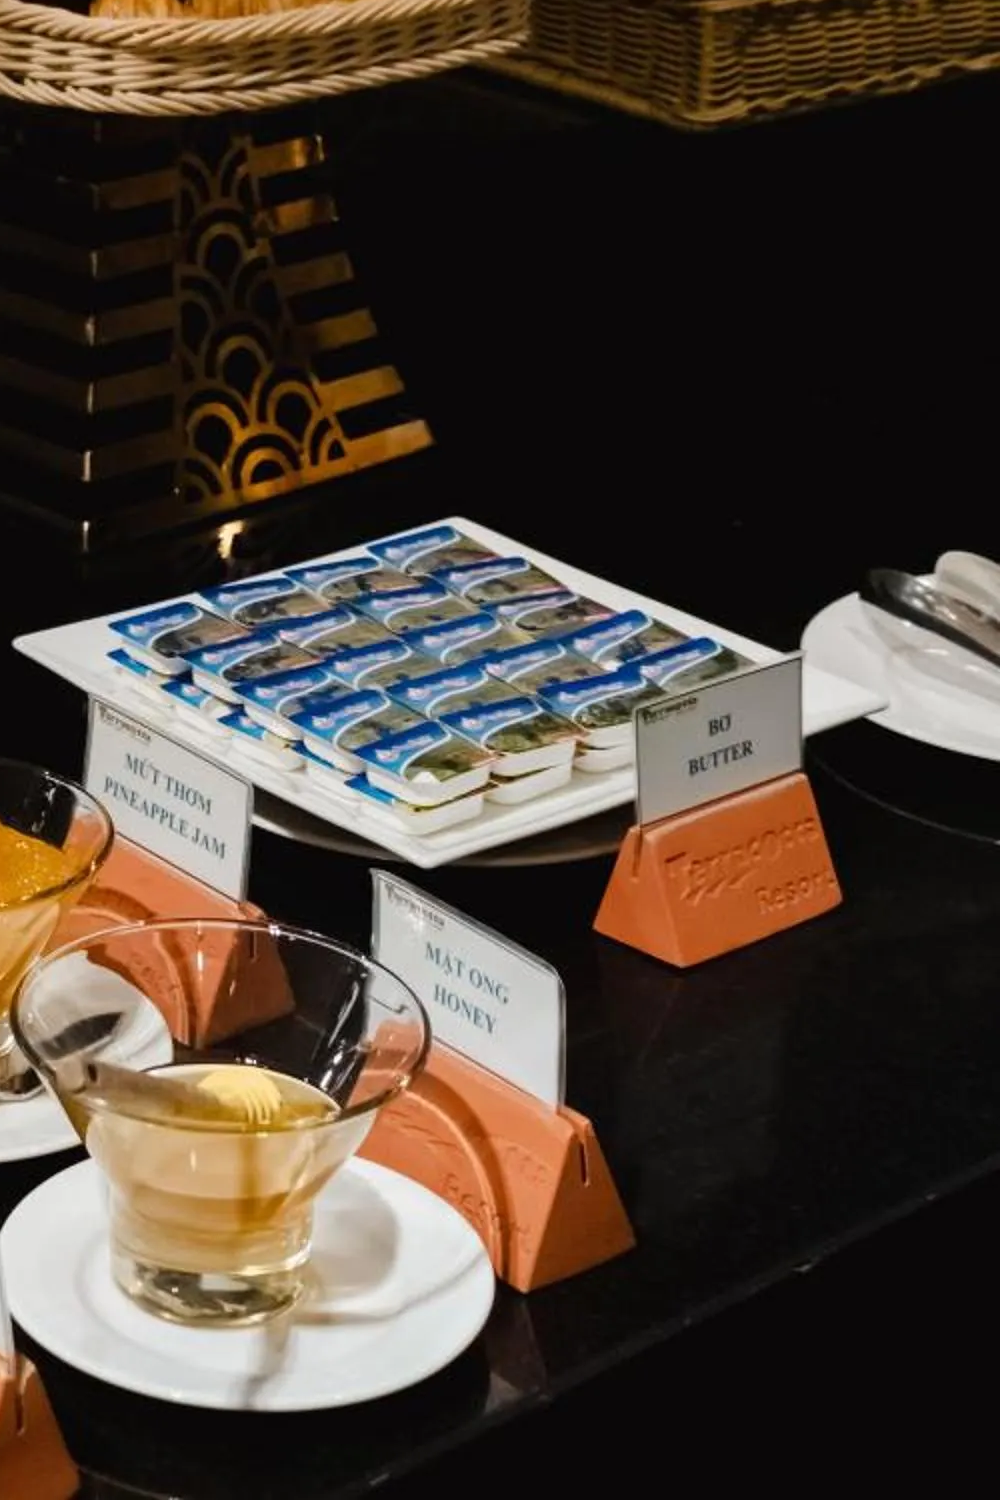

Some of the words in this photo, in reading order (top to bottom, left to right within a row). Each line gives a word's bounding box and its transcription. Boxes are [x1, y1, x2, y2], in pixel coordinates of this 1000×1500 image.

[688, 740, 754, 776] BUTTER
[104, 776, 190, 838] PINEAPPLE
[192, 827, 226, 859] JAM
[469, 969, 510, 1004] ONG
[433, 984, 497, 1034] HONEY
